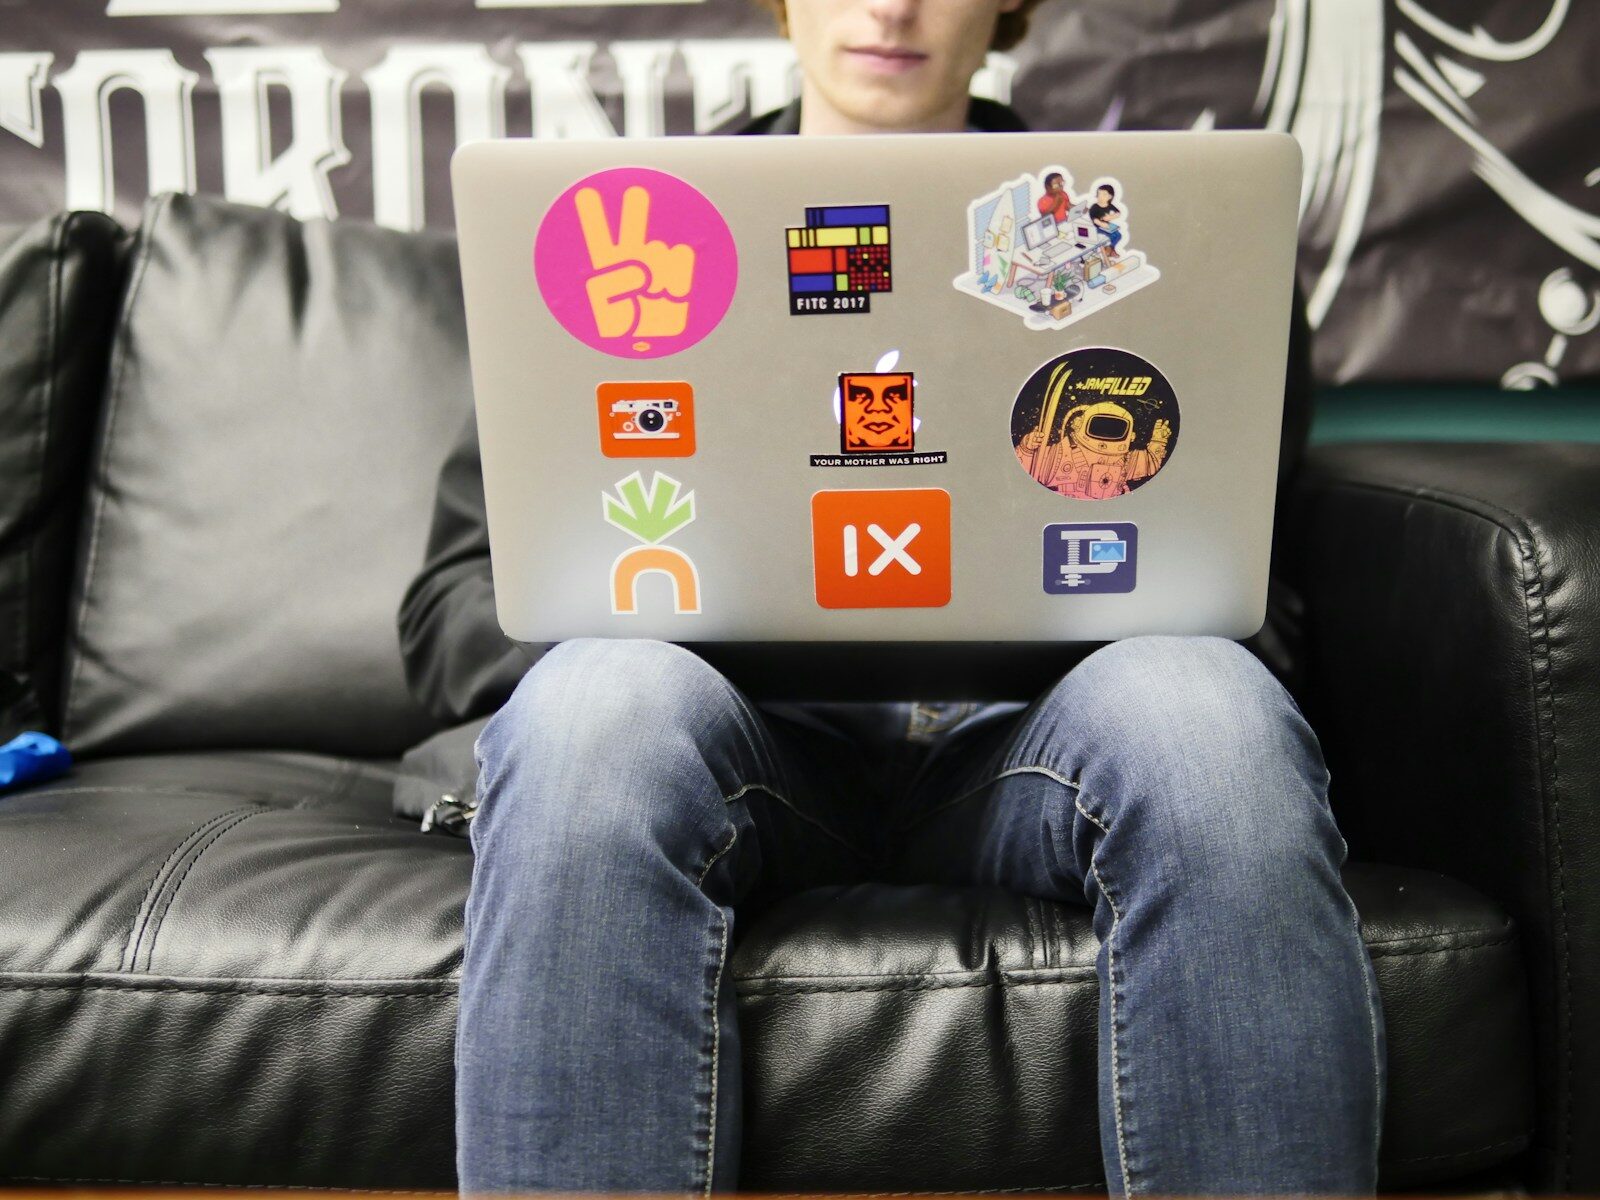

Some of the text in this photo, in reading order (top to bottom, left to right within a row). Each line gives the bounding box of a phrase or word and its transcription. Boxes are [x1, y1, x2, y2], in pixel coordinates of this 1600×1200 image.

[0, 41, 1018, 231] ORON
[796, 296, 866, 311] FITC 2017
[1082, 376, 1153, 396] JAMFILLED
[813, 455, 945, 466] YOUR MOTHER WAS RIGHT
[843, 522, 922, 577] IX
